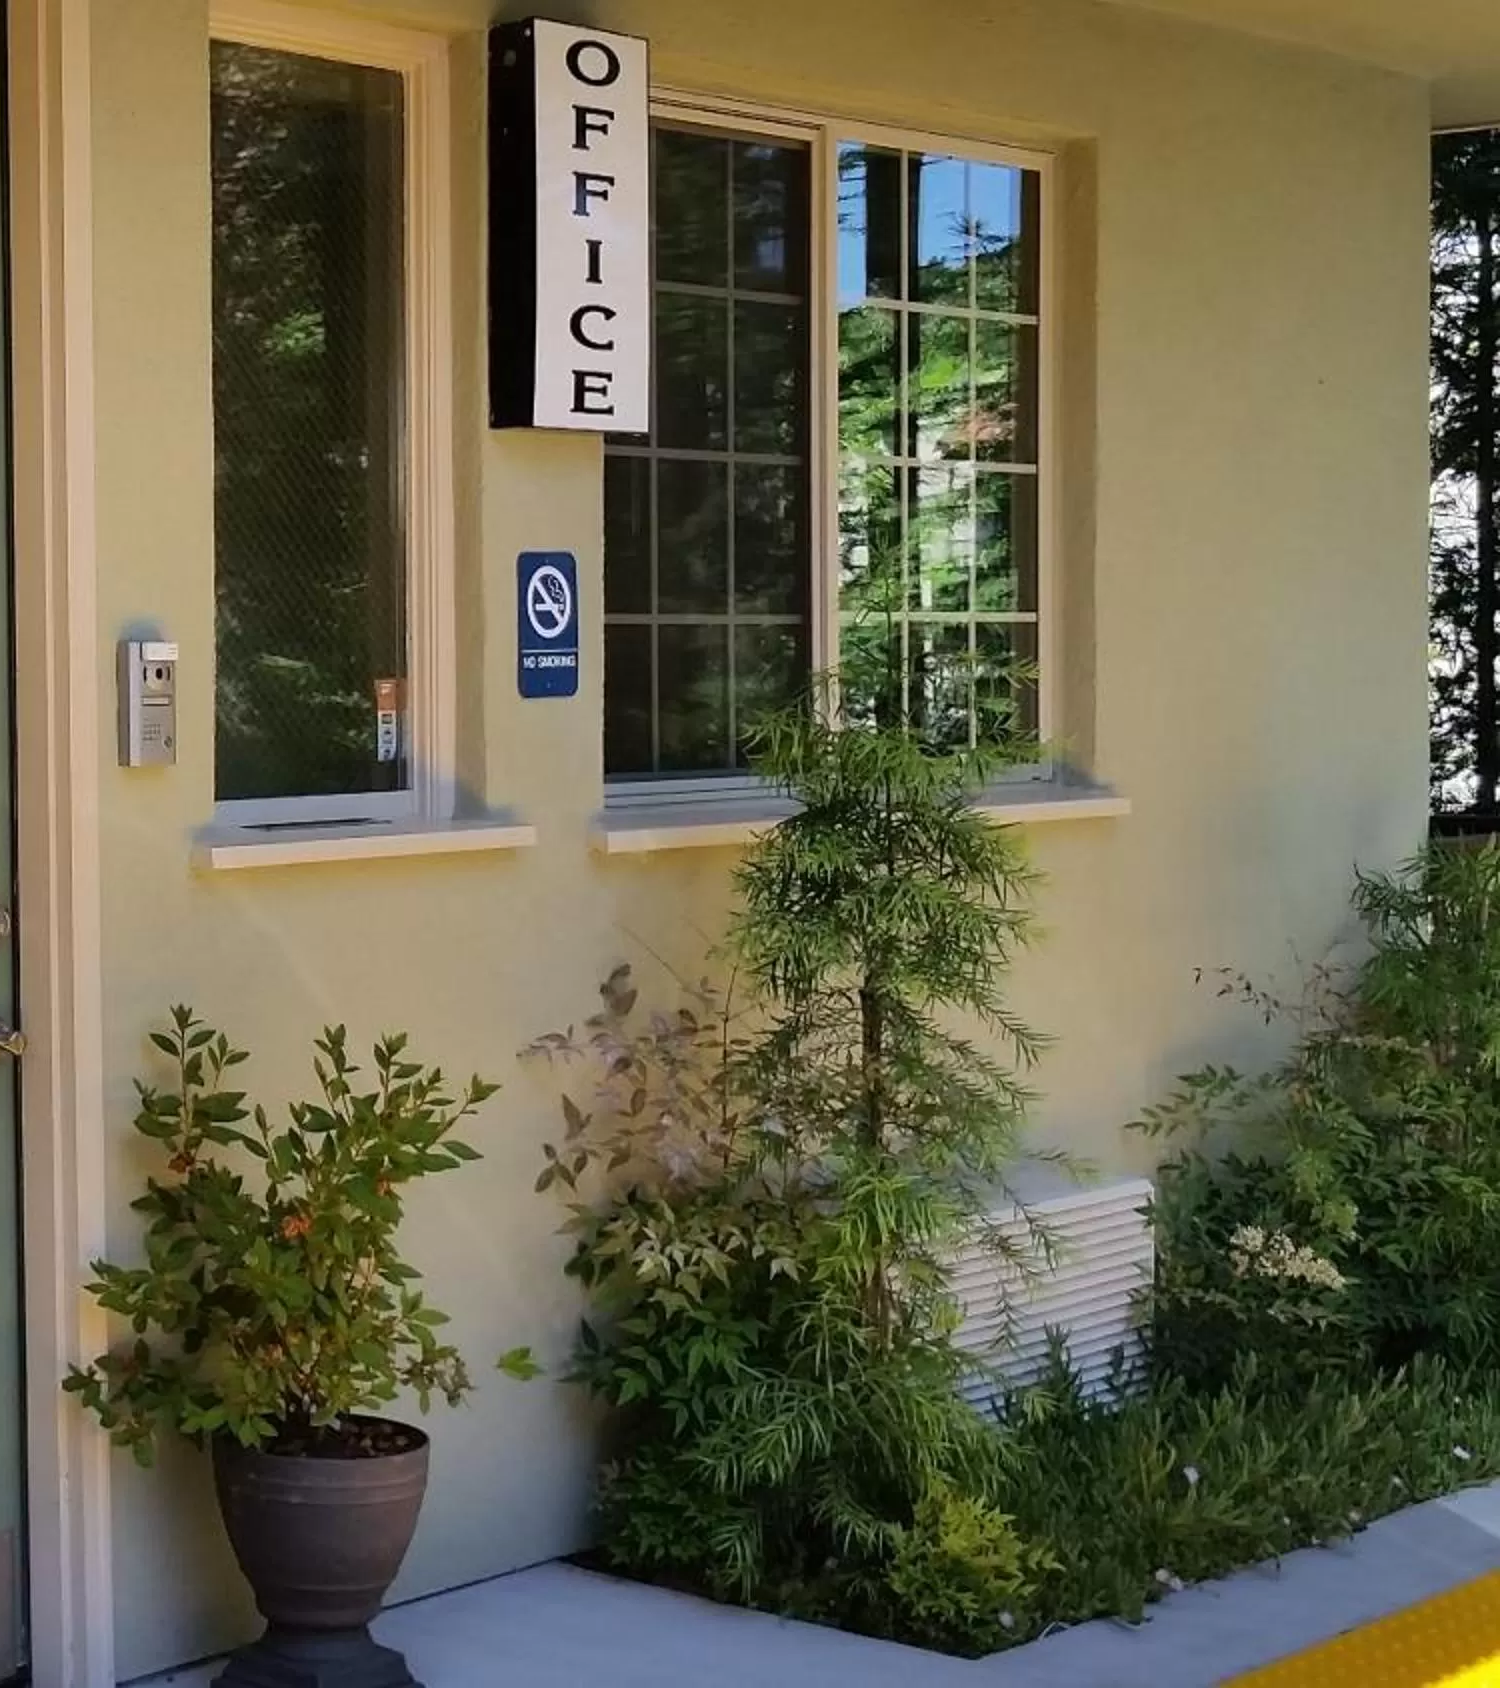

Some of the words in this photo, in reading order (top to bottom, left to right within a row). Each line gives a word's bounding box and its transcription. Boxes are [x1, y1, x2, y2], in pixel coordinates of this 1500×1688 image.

[565, 40, 621, 416] OFFICE
[523, 656, 537, 669] NO
[537, 655, 576, 668] SMOKING
